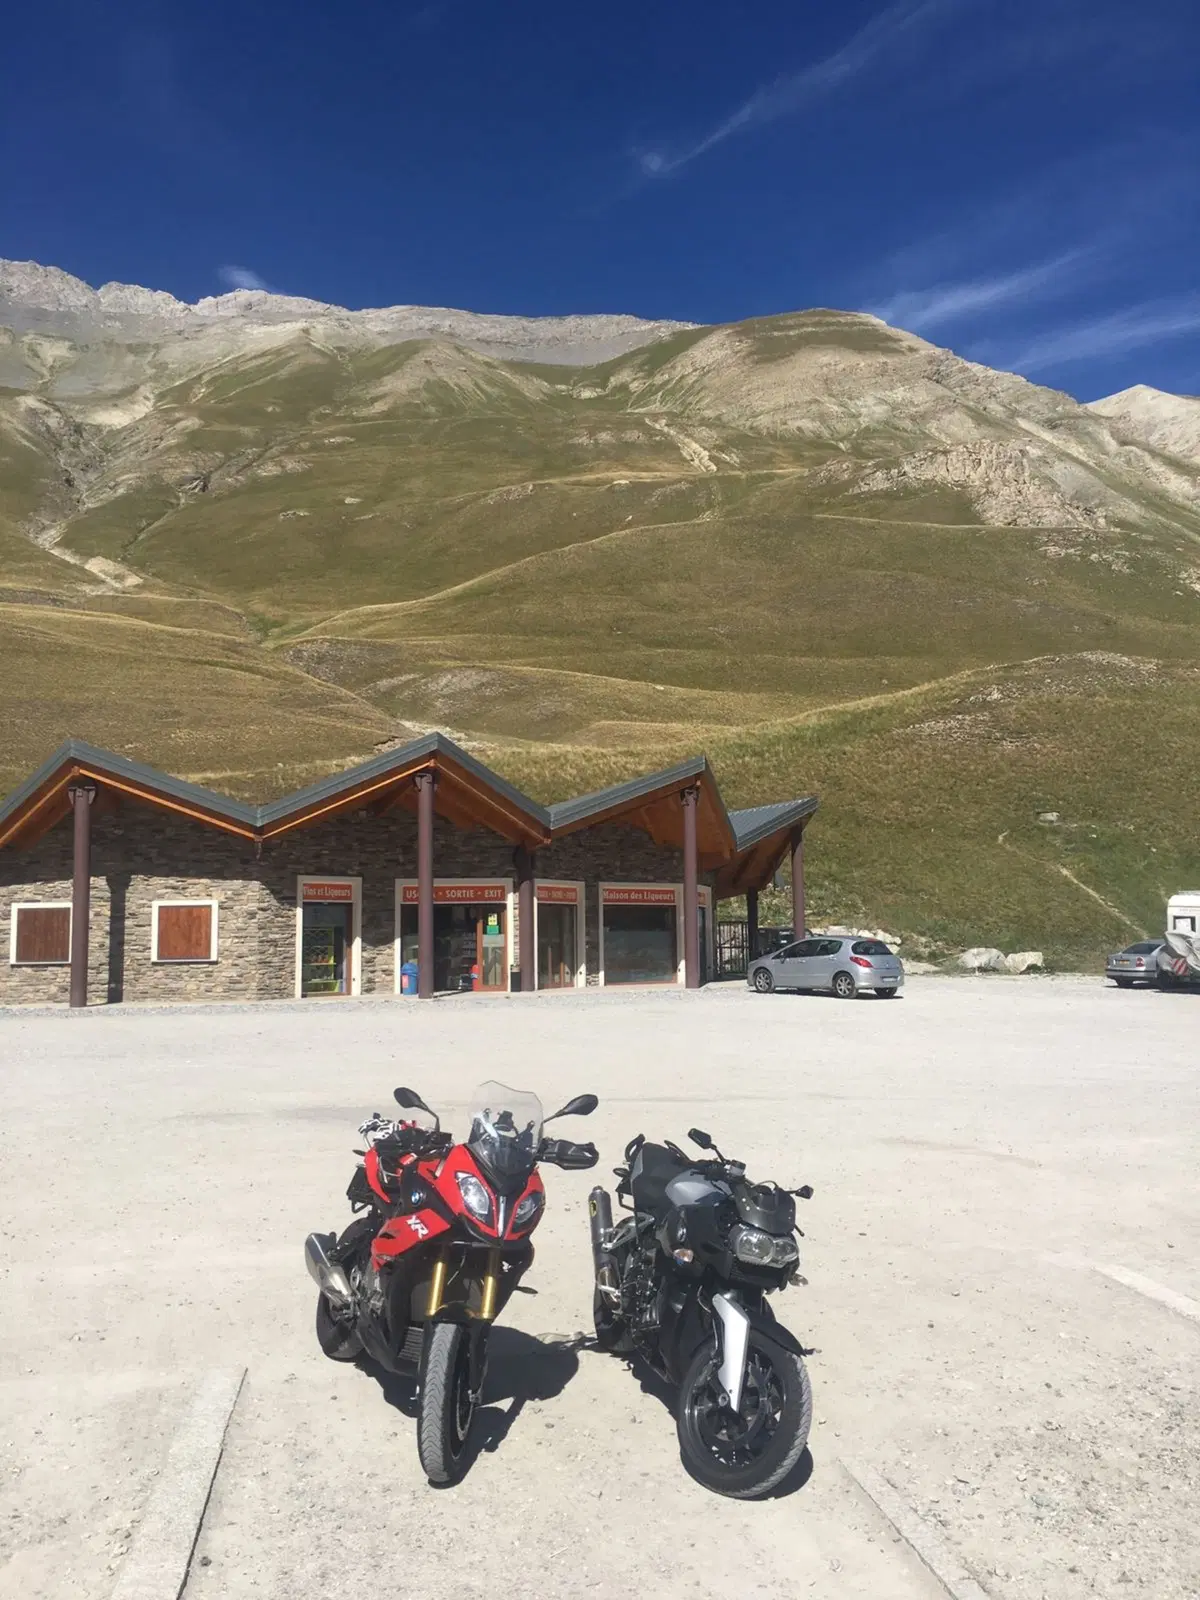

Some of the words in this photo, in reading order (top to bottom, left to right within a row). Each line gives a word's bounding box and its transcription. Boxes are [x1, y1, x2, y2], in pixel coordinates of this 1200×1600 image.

[445, 889, 475, 898] SORTIE
[484, 889, 502, 898] EXIT
[602, 889, 629, 899] Maison
[630, 890, 642, 899] des
[644, 890, 675, 901] Liqueurs
[405, 1214, 429, 1240] XR
